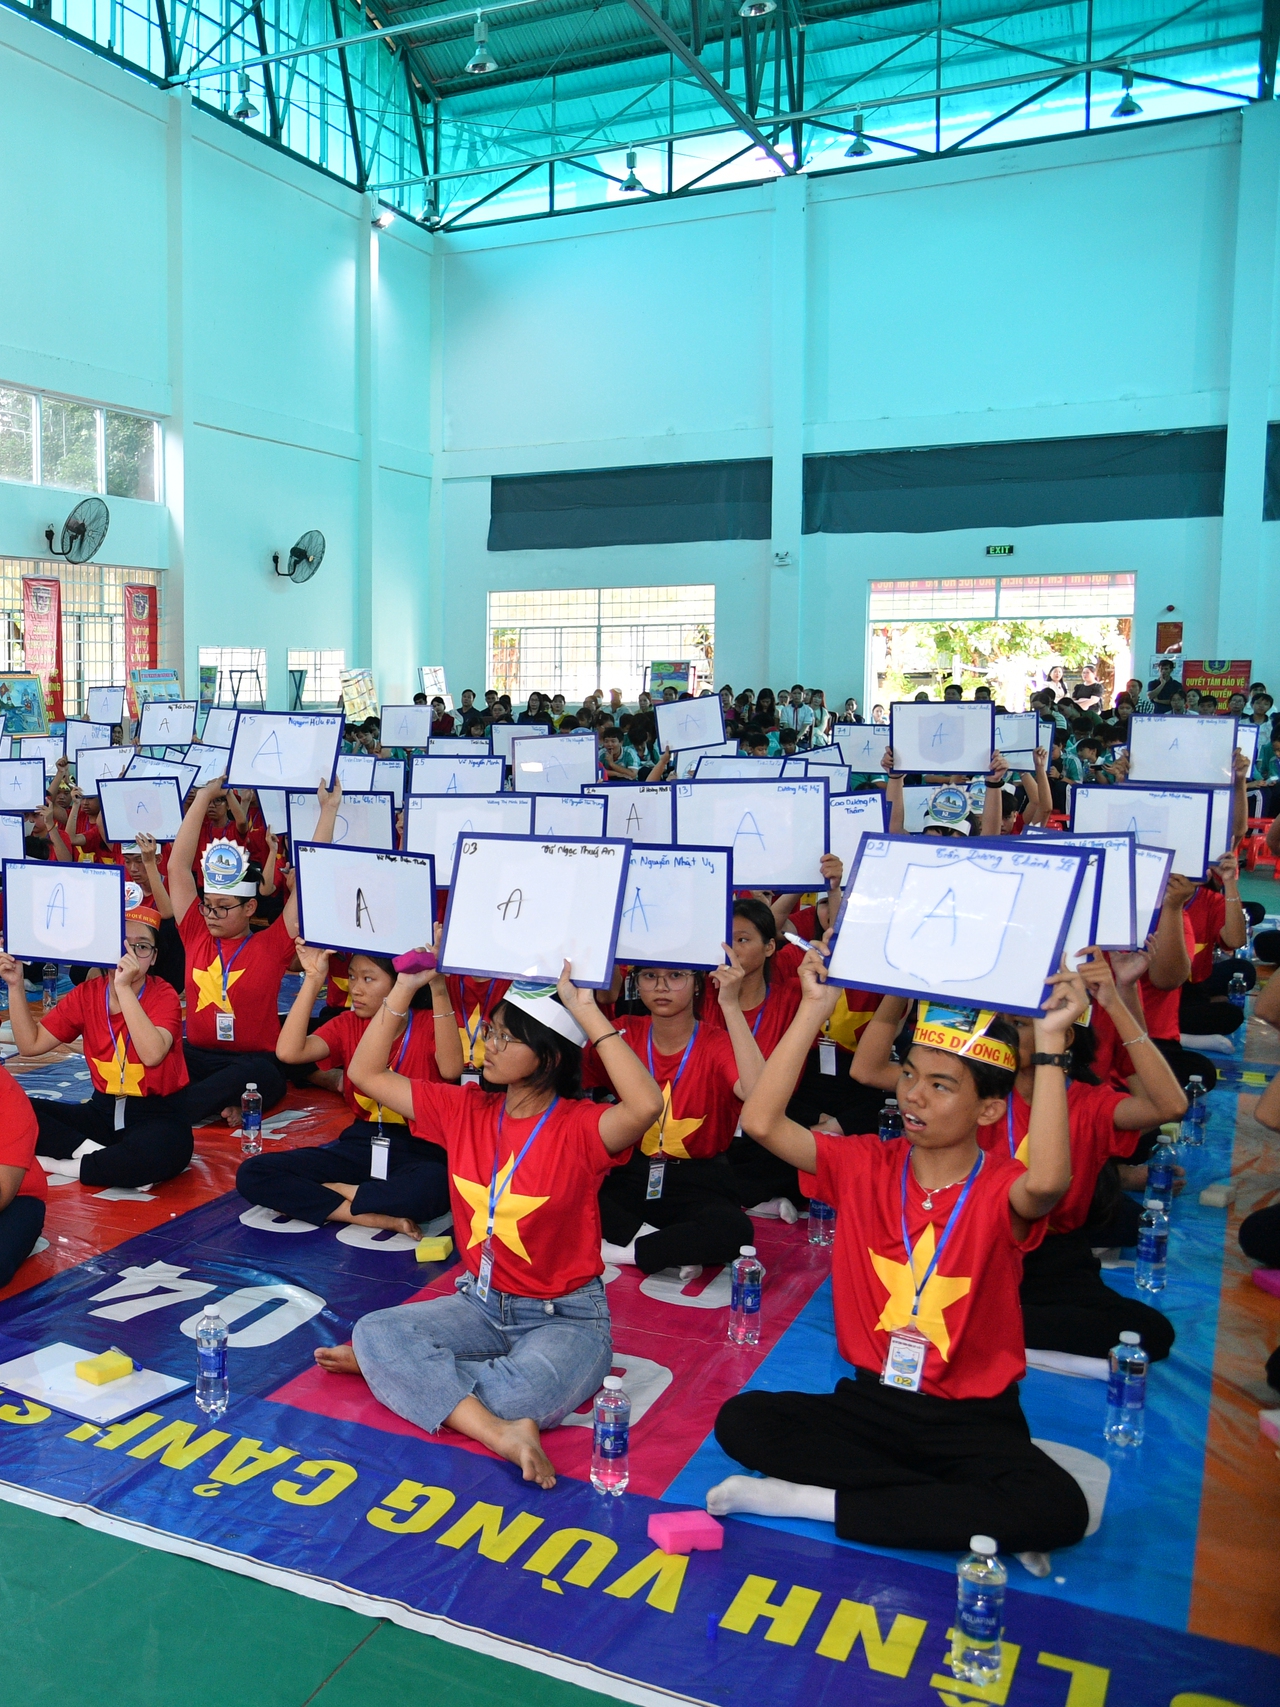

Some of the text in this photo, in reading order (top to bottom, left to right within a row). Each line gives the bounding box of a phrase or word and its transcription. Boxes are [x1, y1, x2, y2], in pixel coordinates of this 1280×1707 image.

[990, 546, 1010, 554] EXIT
[1185, 675, 1245, 687] QUYẾT TÂM BẢO VỆ
[1212, 689, 1232, 698] QUYỀN
[101, 697, 109, 713] A
[159, 718, 169, 733] A
[399, 715, 408, 735] A
[679, 714, 700, 732] A
[931, 723, 949, 748] A
[861, 740, 873, 757] A
[1169, 738, 1179, 750] A
[251, 730, 283, 775] A
[99, 763, 113, 778] A
[205, 759, 217, 774] A
[10, 776, 22, 791] A
[446, 773, 457, 793] A
[678, 786, 689, 794] 13
[137, 801, 149, 814] A
[290, 795, 306, 805] 20
[830, 800, 845, 808] Cao
[626, 803, 643, 834] A
[732, 811, 766, 851] A
[463, 842, 478, 854] 03
[601, 846, 615, 856] An
[867, 841, 885, 851] 02
[46, 883, 68, 930] A
[356, 887, 375, 933] A
[497, 888, 528, 921] A
[622, 886, 658, 932] A
[910, 887, 958, 947] A
[914, 1027, 945, 1045] THCS
[88, 1260, 327, 1348] 04
[893, 1374, 912, 1387] 02
[65, 1411, 358, 1506] CẢNH
[367, 1479, 689, 1614] VÙNG
[961, 1611, 996, 1626] AQUAFINA
